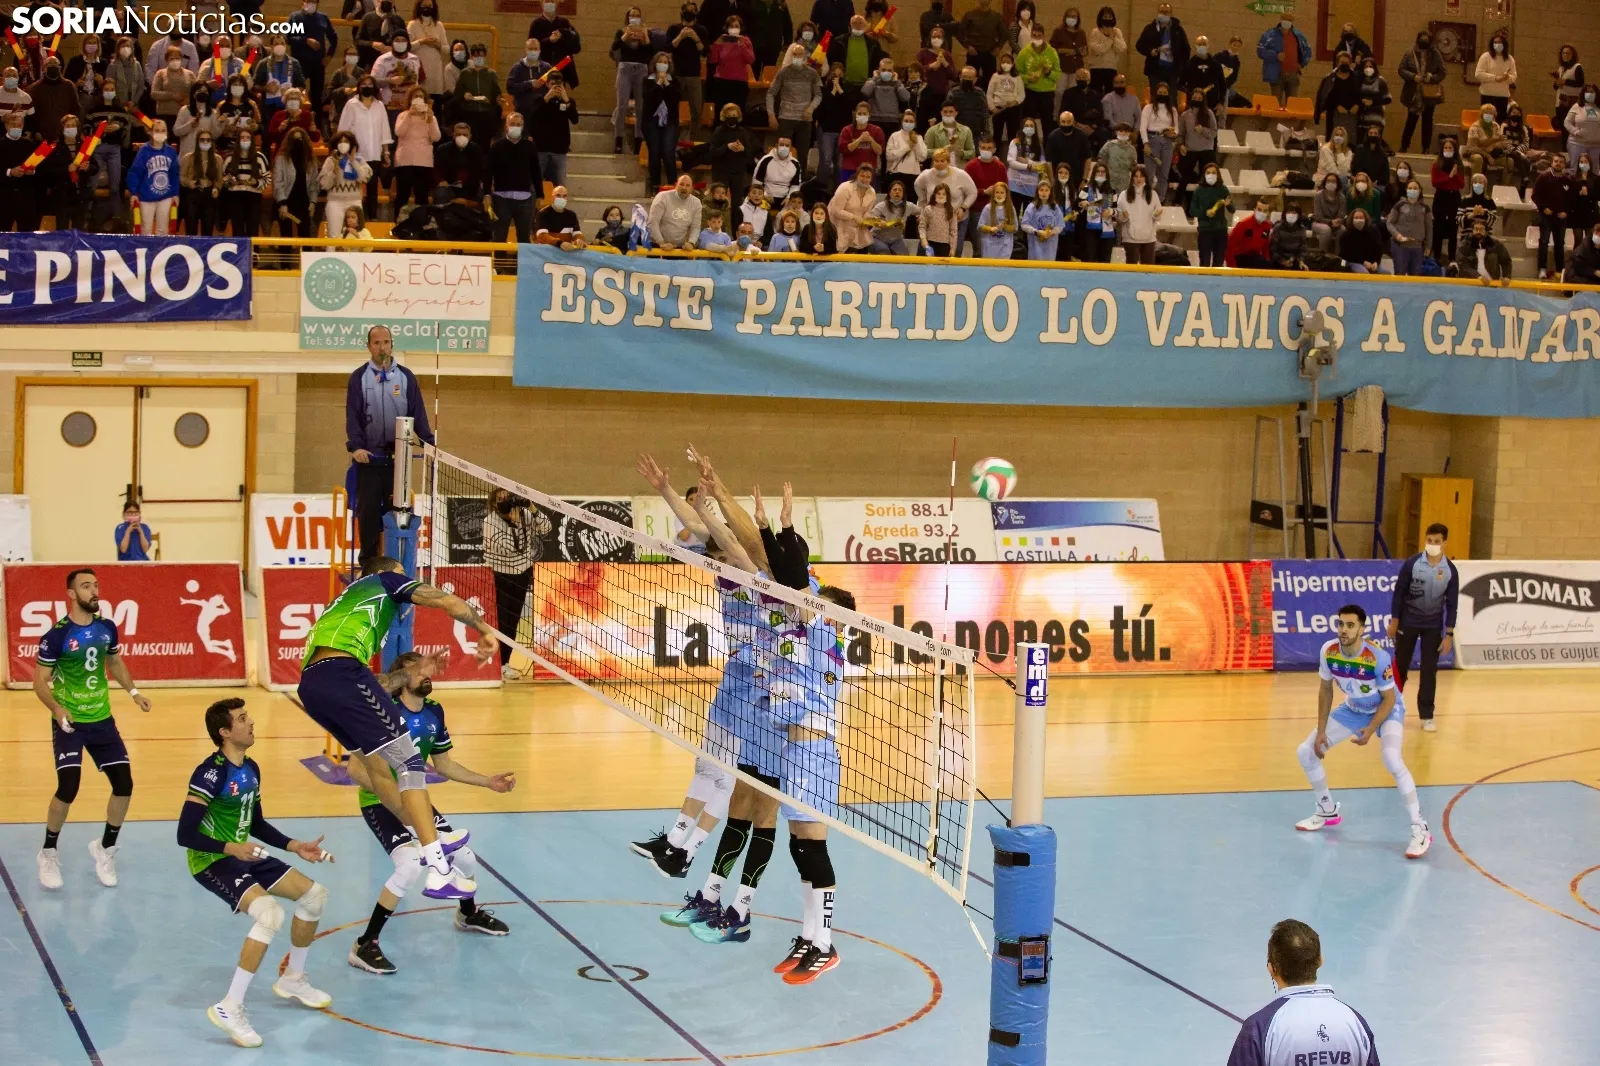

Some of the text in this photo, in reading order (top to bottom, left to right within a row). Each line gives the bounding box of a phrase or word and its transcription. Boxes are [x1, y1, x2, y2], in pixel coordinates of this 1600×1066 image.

[33, 242, 245, 304] PINOS
[362, 263, 401, 284] Ms.
[540, 262, 1600, 363] ESTE PARTIDO LO VAMOS A GANAR
[325, 336, 346, 346] 635
[865, 503, 948, 517] Soria 88.1
[862, 520, 960, 541] Ágreda 93.2
[1271, 569, 1399, 597] Hipermerca
[1488, 577, 1594, 608] ALJOMAR
[653, 606, 711, 668] La
[1109, 603, 1172, 663] tú.
[84, 646, 99, 672] 8
[132, 642, 194, 656] MASCULINA
[1483, 647, 1537, 661] IBÉRICOS
[1541, 648, 1556, 660] DE
[1294, 1050, 1352, 1066] RFEVB
